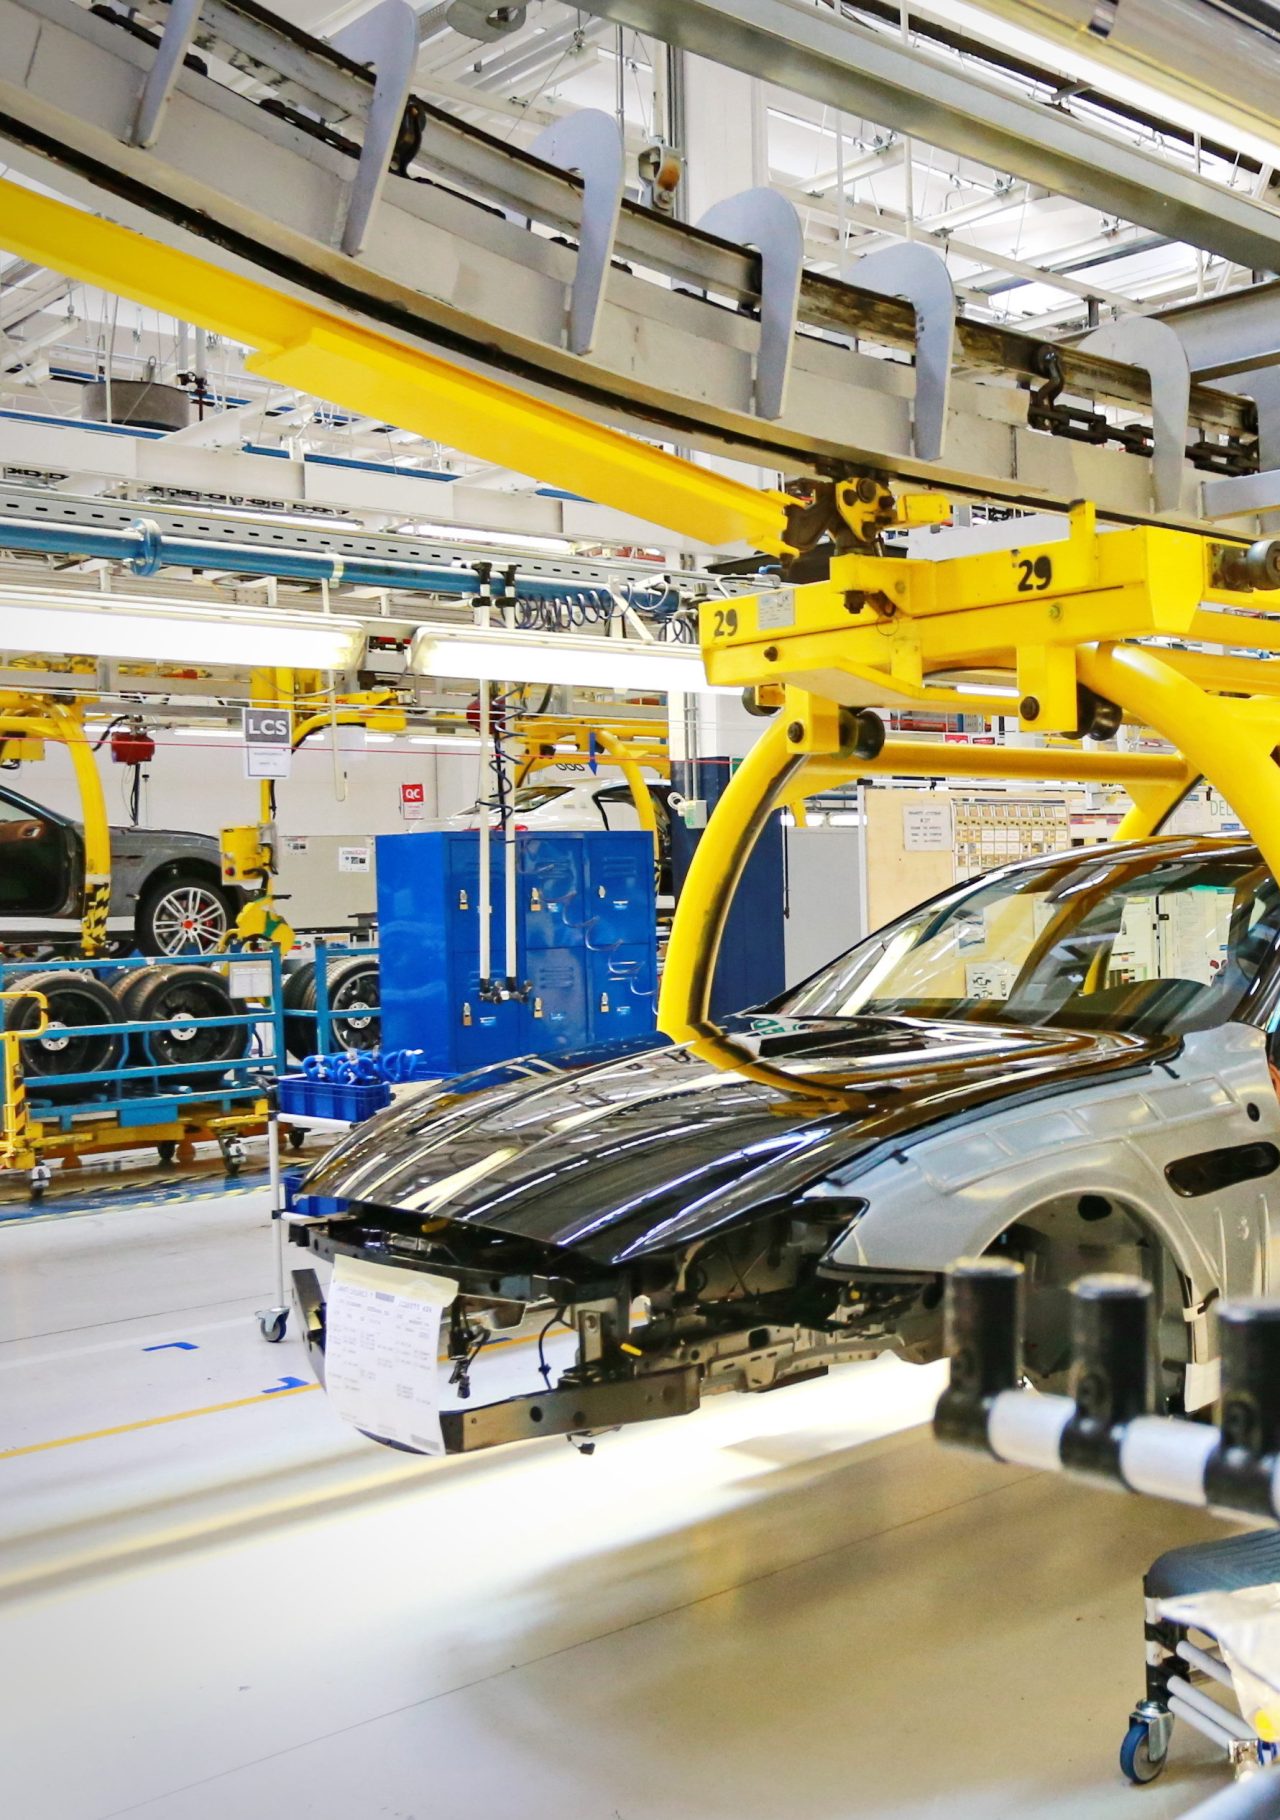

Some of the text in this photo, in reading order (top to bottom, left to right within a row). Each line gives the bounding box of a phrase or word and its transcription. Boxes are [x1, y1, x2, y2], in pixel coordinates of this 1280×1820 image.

[1017, 555, 1053, 593] 29
[713, 608, 739, 638] 29
[248, 718, 288, 736] LCS
[405, 788, 421, 800] QC
[1210, 800, 1235, 816] DEL
